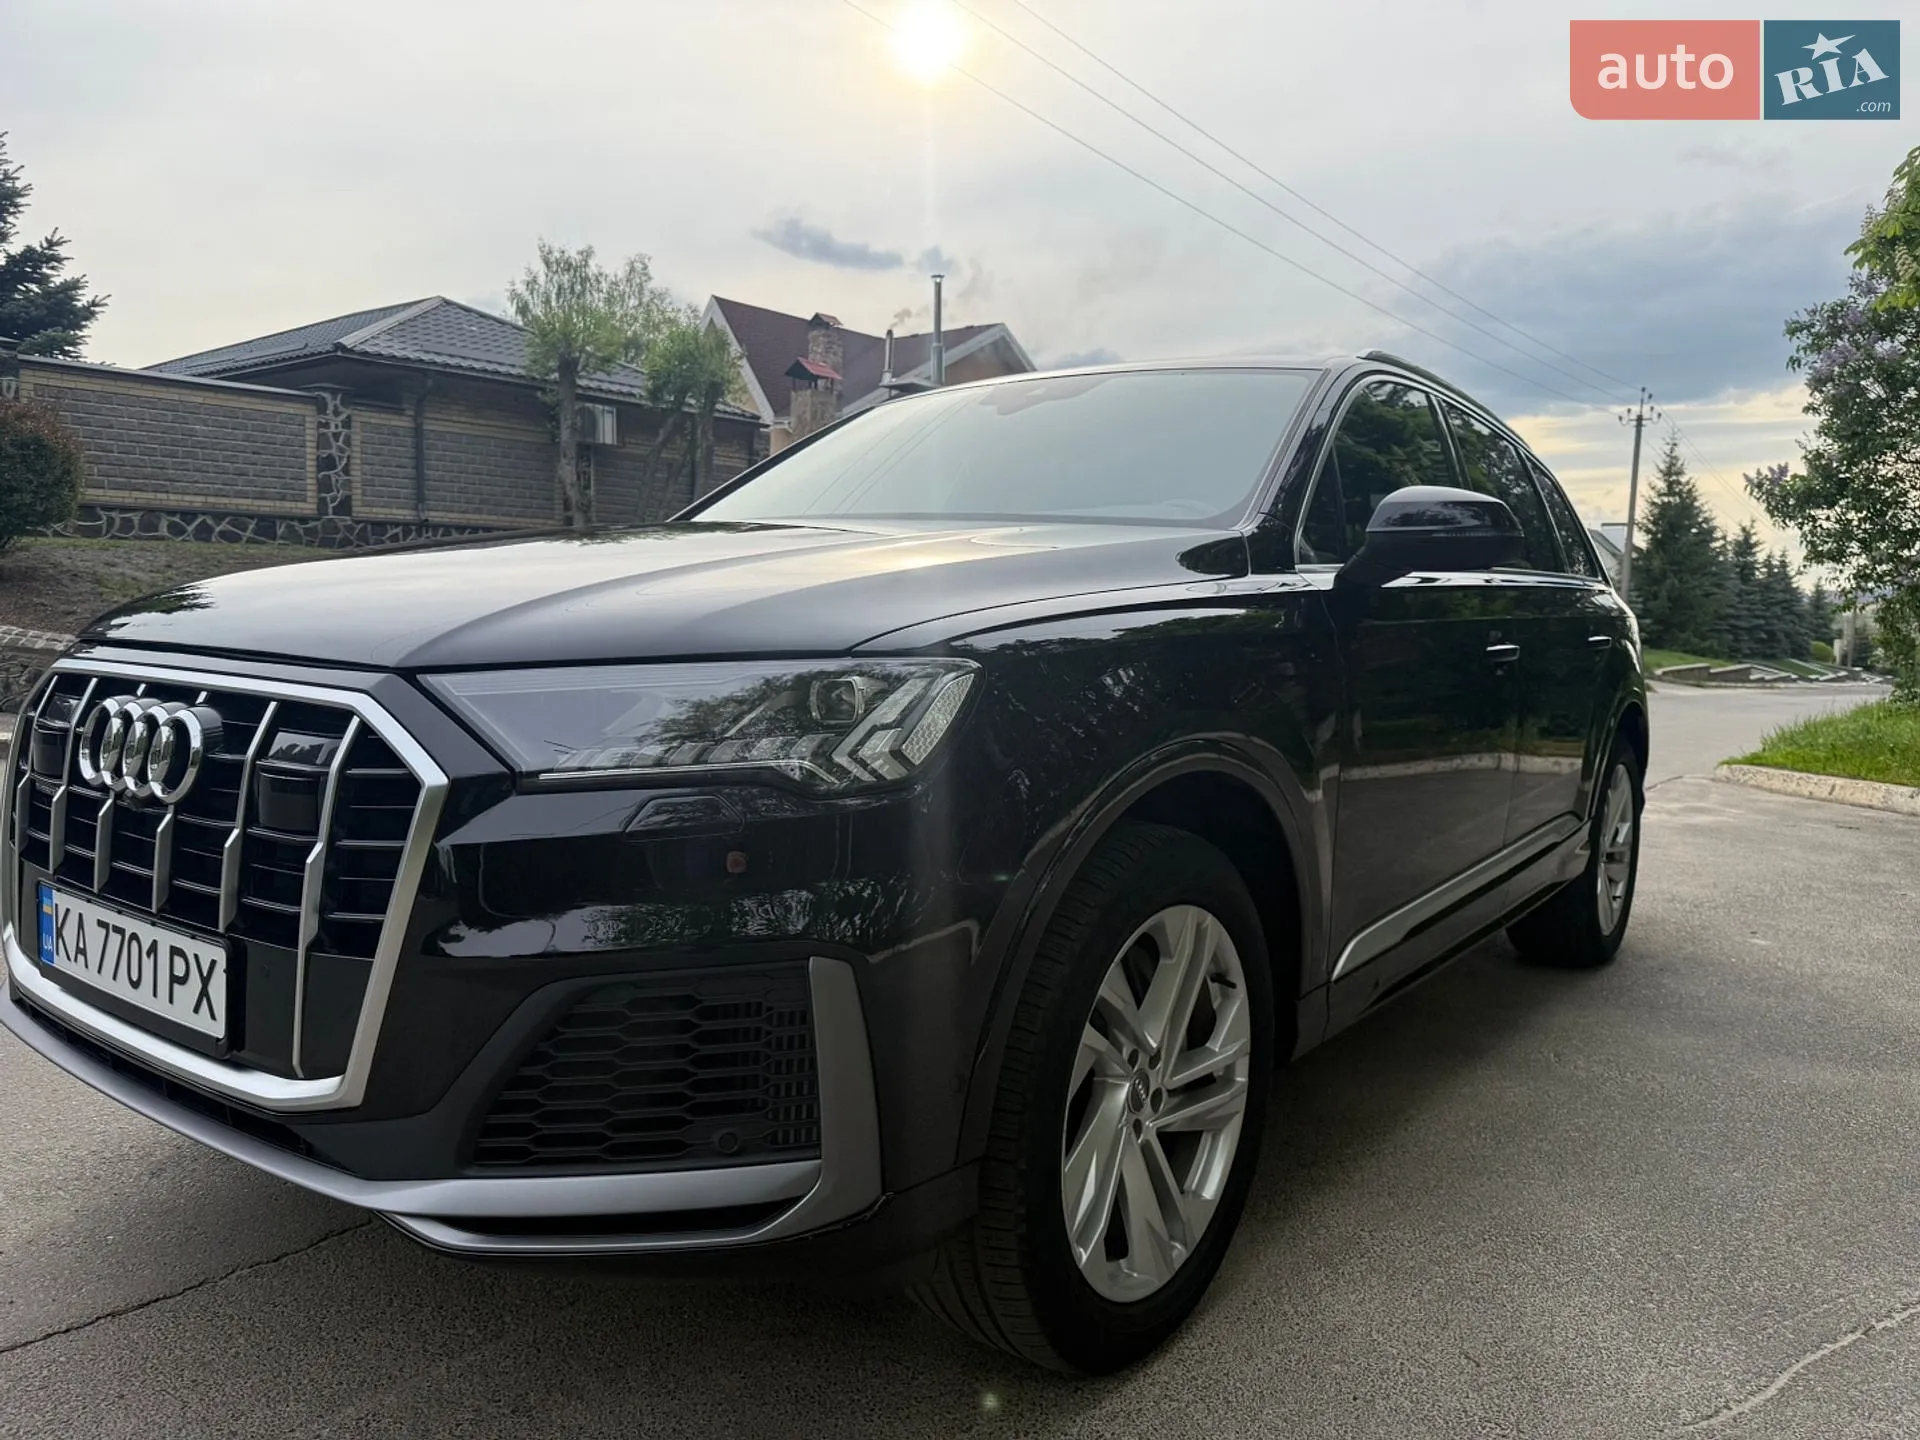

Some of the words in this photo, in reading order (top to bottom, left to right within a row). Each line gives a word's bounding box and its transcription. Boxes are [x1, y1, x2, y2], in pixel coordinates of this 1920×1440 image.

[42, 933, 53, 952] UA
[55, 904, 89, 969] KA
[97, 919, 158, 998] 7701
[169, 945, 217, 1021] PX
